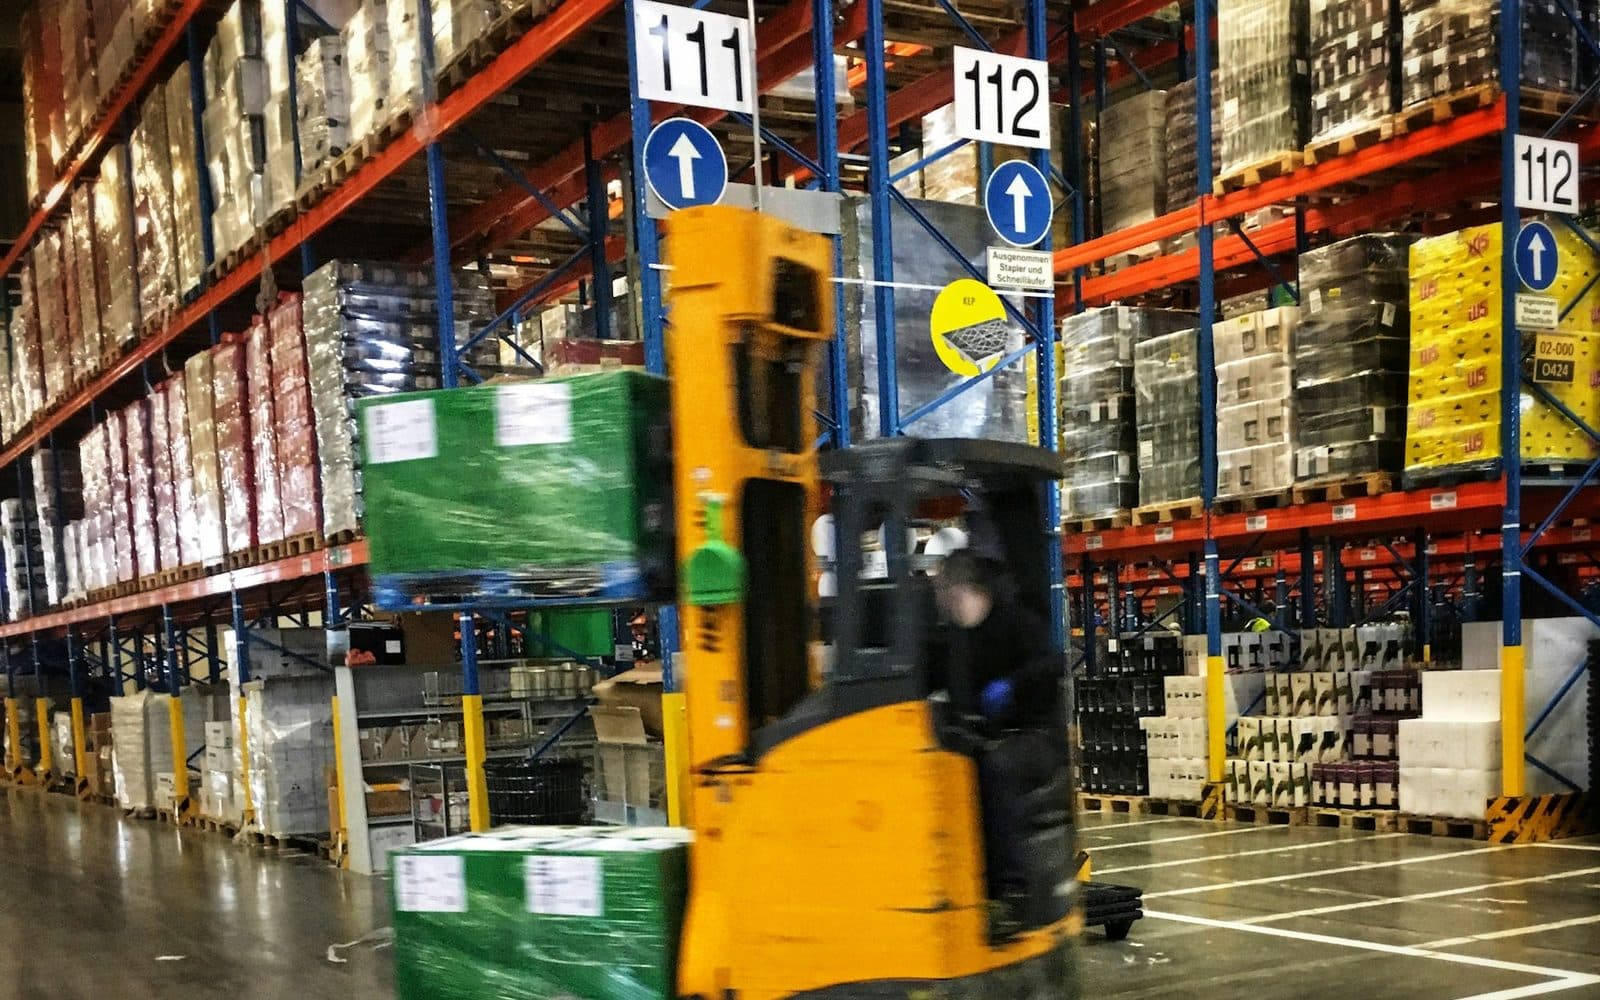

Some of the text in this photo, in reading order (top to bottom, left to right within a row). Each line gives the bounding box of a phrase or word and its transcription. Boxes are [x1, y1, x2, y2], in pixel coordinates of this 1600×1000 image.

[649, 14, 743, 102] 111
[965, 60, 1040, 138] 112
[1521, 144, 1572, 206] 112
[992, 251, 1049, 263] Ausgenommen
[999, 262, 1043, 274] Stapler und
[1540, 341, 1574, 356] 02-000
